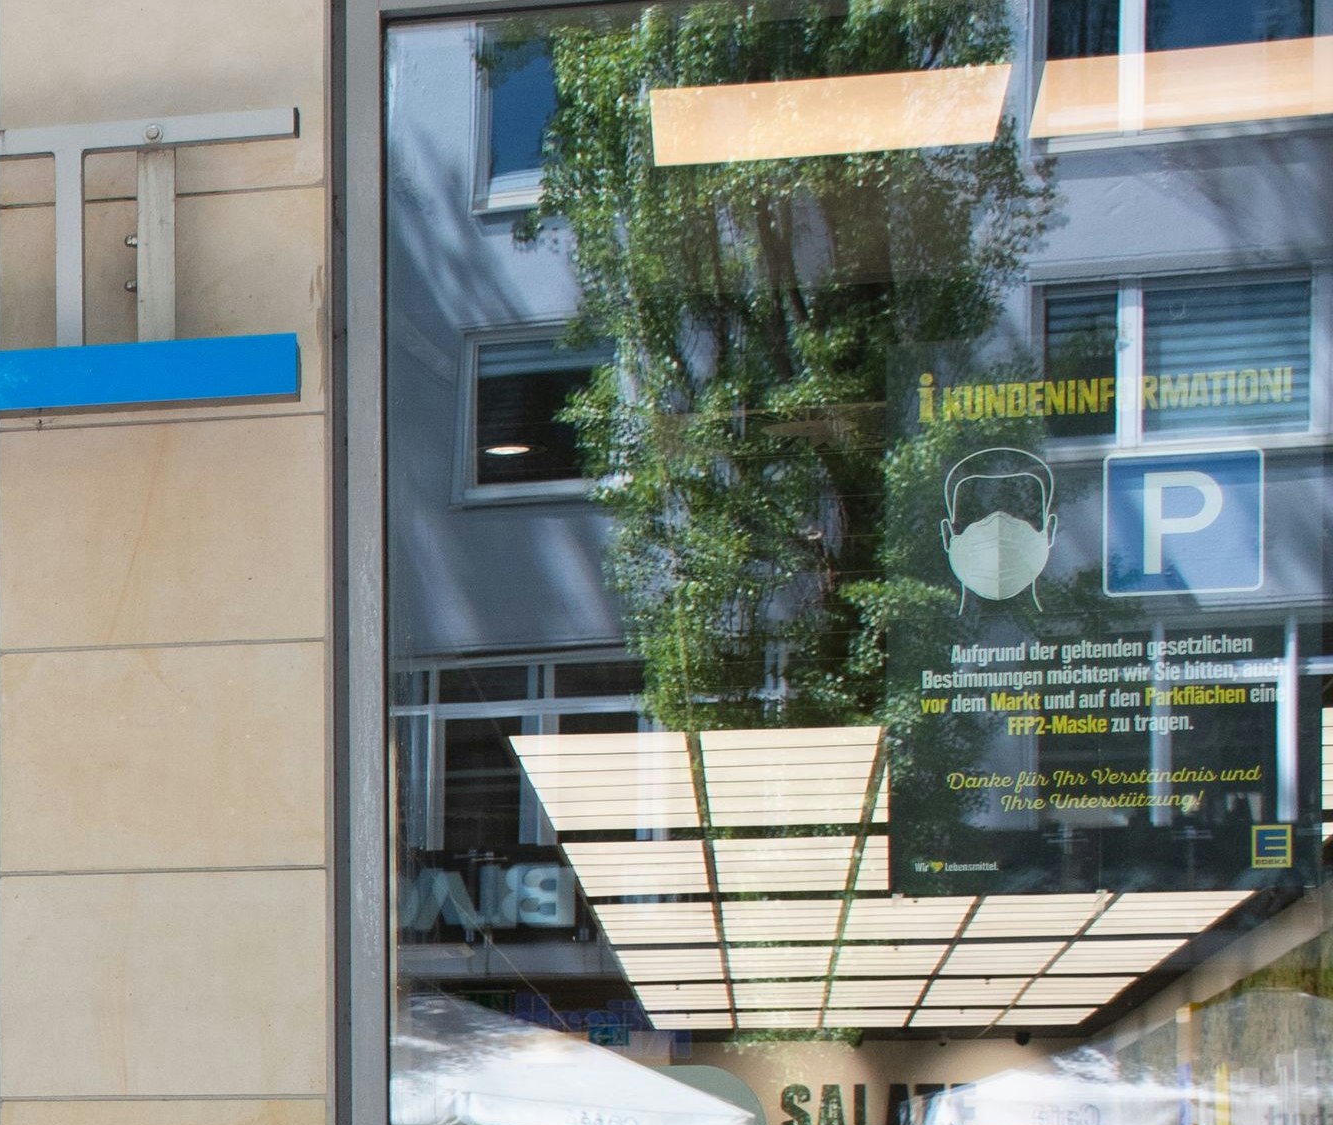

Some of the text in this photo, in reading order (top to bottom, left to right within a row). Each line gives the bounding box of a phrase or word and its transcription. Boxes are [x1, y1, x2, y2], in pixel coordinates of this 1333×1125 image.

[943, 367, 1293, 421] KUNDENINFRMATION!
[1143, 470, 1224, 575] P
[951, 634, 1253, 666] Aufgrund der geltenden gesetzlichen
[921, 668, 1044, 692] Bestimmungen
[1047, 664, 1119, 686] möchten
[1122, 662, 1150, 683] wir
[1155, 661, 1181, 682] Sie
[1184, 659, 1237, 682] bitten,
[921, 698, 948, 714] vor
[951, 694, 987, 713] dem
[991, 691, 1041, 711] Markt
[1044, 690, 1075, 710] und
[1079, 689, 1106, 709] auf
[1109, 687, 1140, 708] den
[1145, 685, 1246, 708] Parkflächen
[1007, 714, 1194, 736] FFP2-Maske zu tragen.
[947, 765, 1261, 795] Danke für Ihr Verständnis und
[1001, 791, 1205, 813] Ihre Unterstützung!
[915, 861, 999, 872] Wir Lebensmittel.
